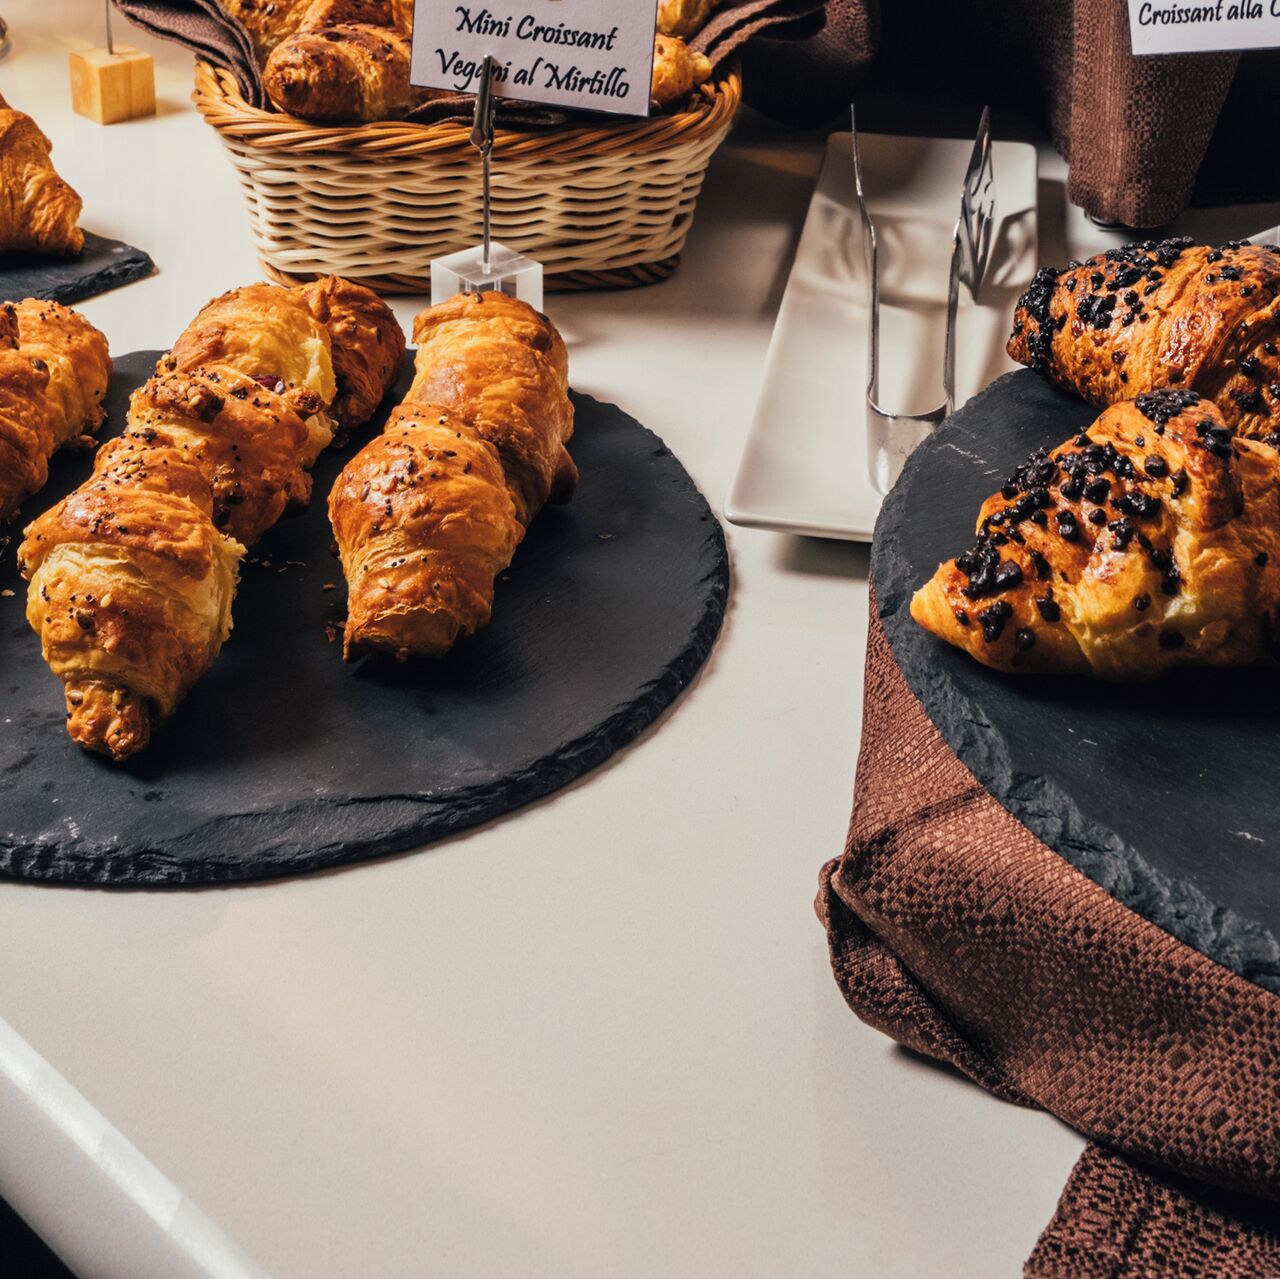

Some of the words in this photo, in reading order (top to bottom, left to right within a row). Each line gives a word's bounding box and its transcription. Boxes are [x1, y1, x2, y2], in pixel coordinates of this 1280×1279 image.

[455, 5, 513, 37] Mini
[516, 14, 619, 51] Croissant
[512, 56, 544, 86] al
[544, 62, 631, 99] Mirtillo
